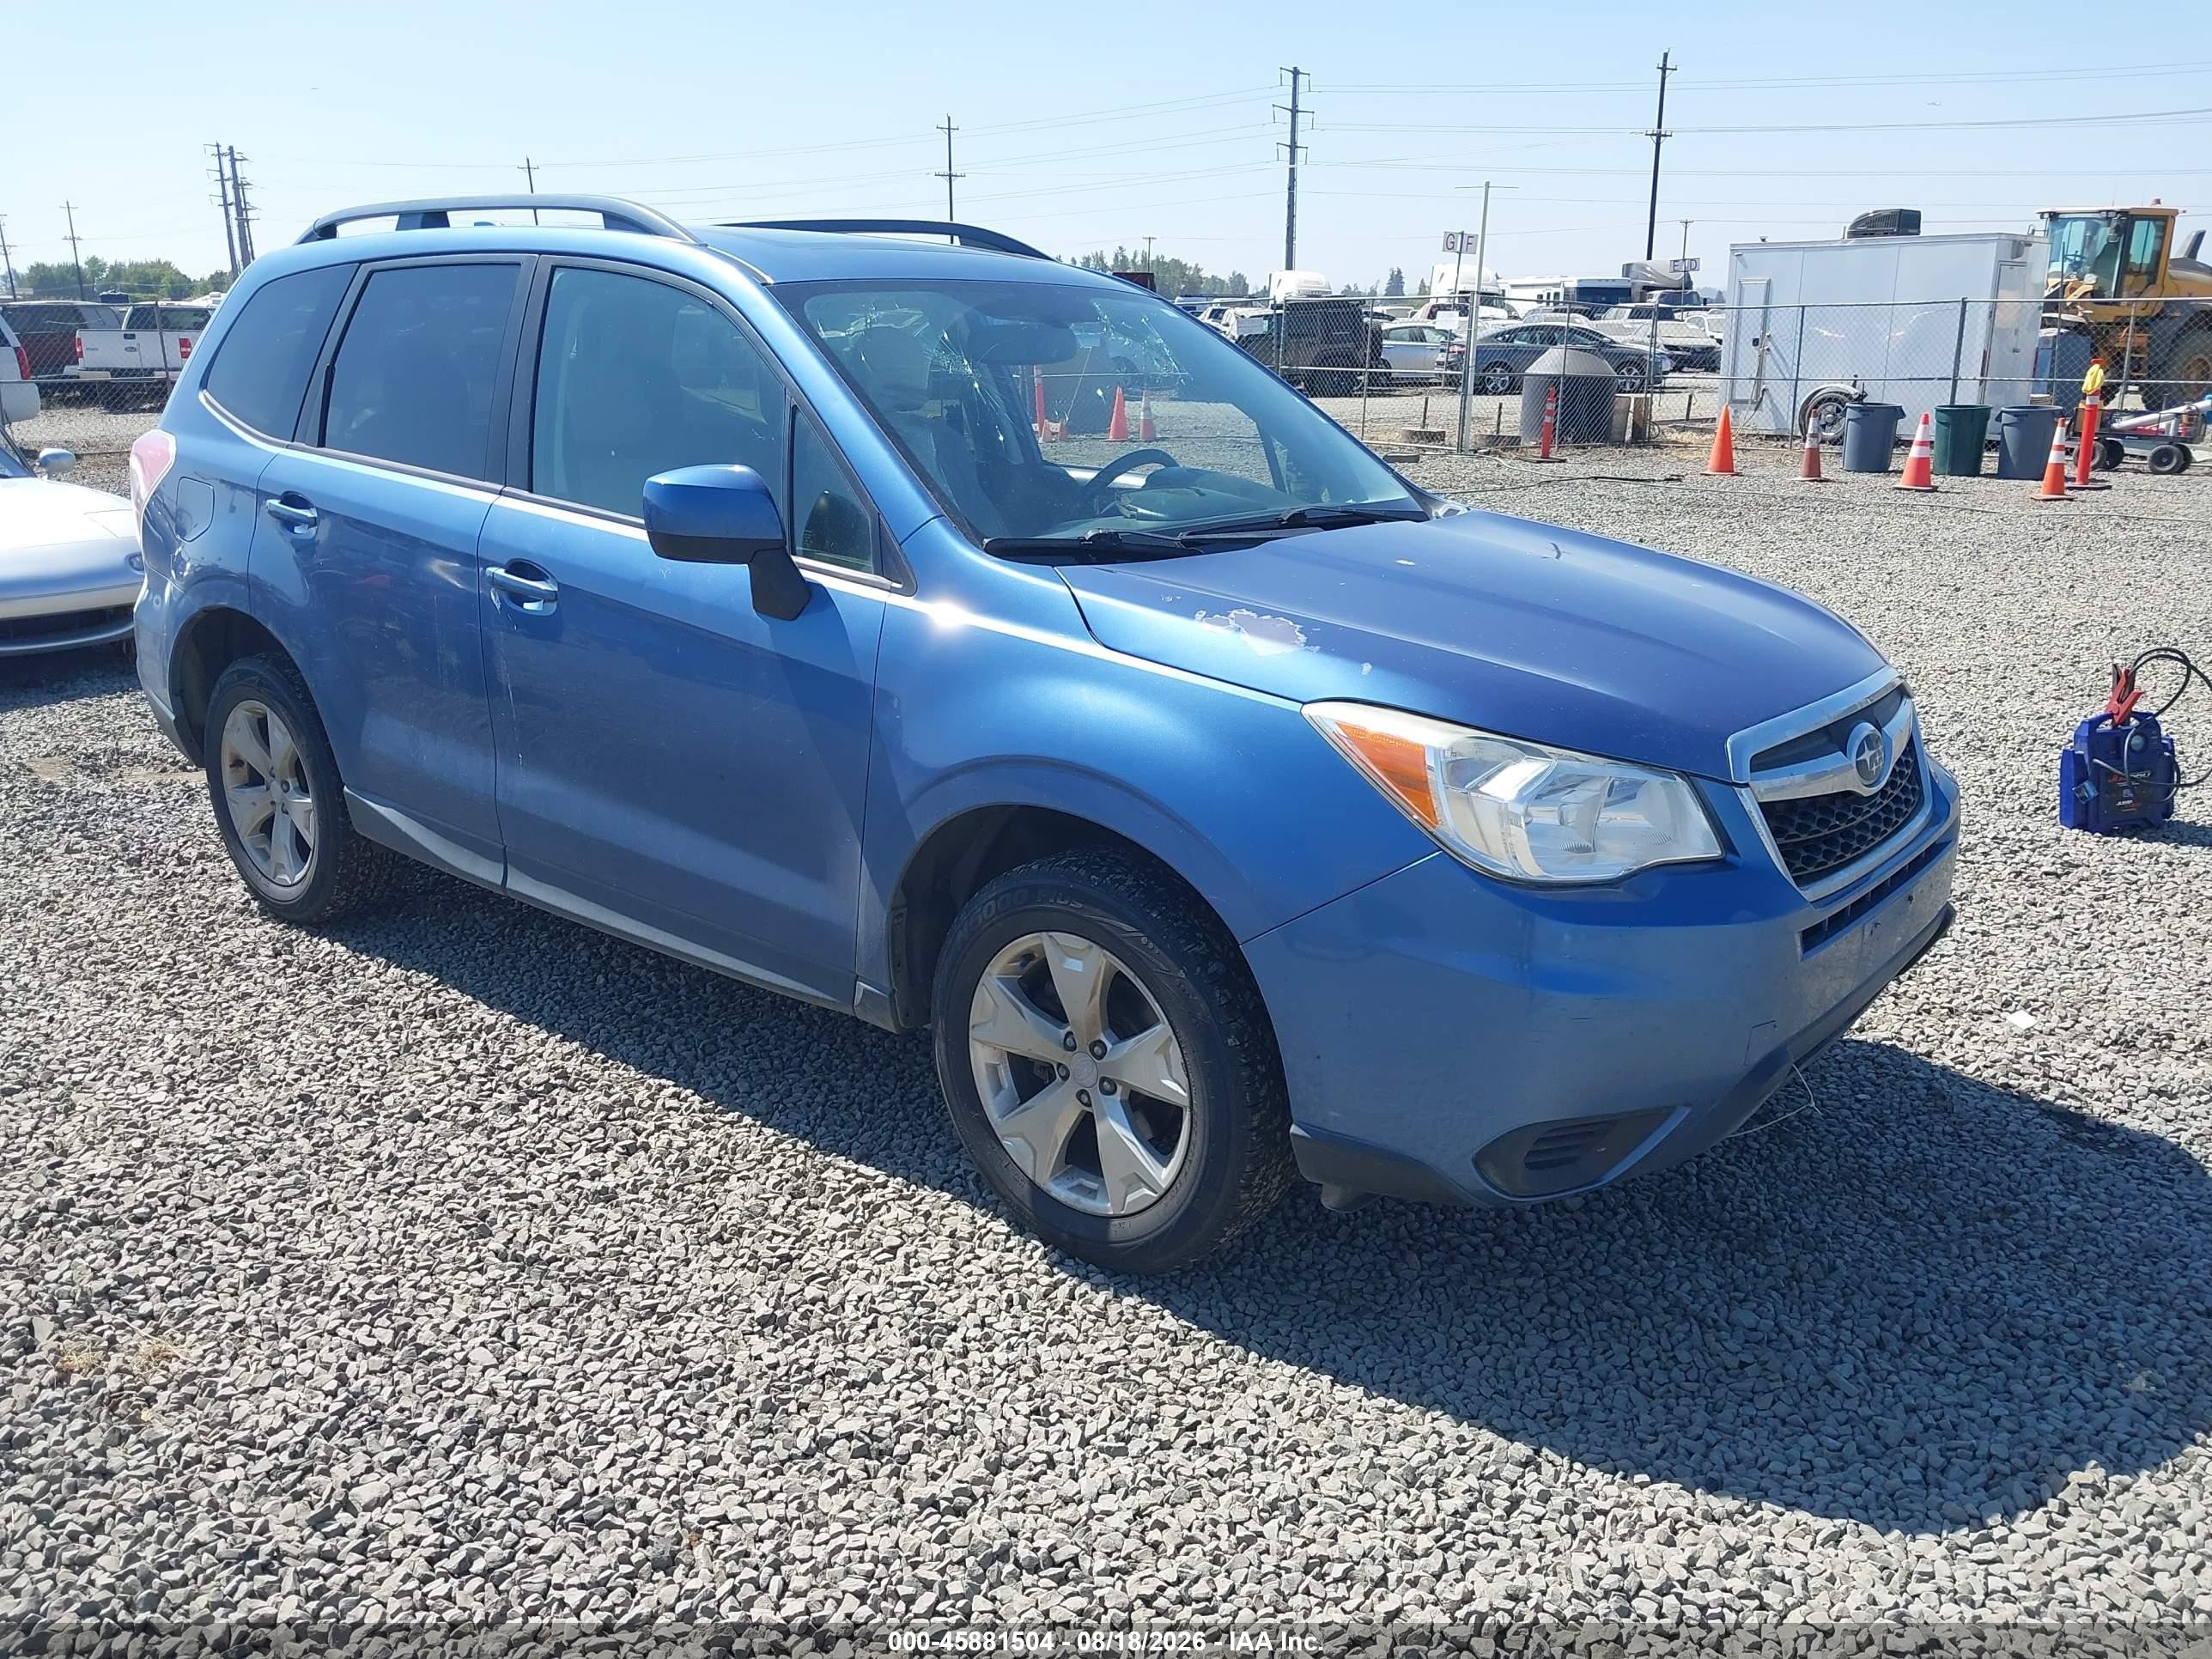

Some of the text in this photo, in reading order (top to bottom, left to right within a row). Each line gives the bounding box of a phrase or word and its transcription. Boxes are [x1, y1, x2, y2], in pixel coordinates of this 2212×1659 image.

[1446, 234, 1474, 252] G F
[1689, 259, 1698, 270] D
